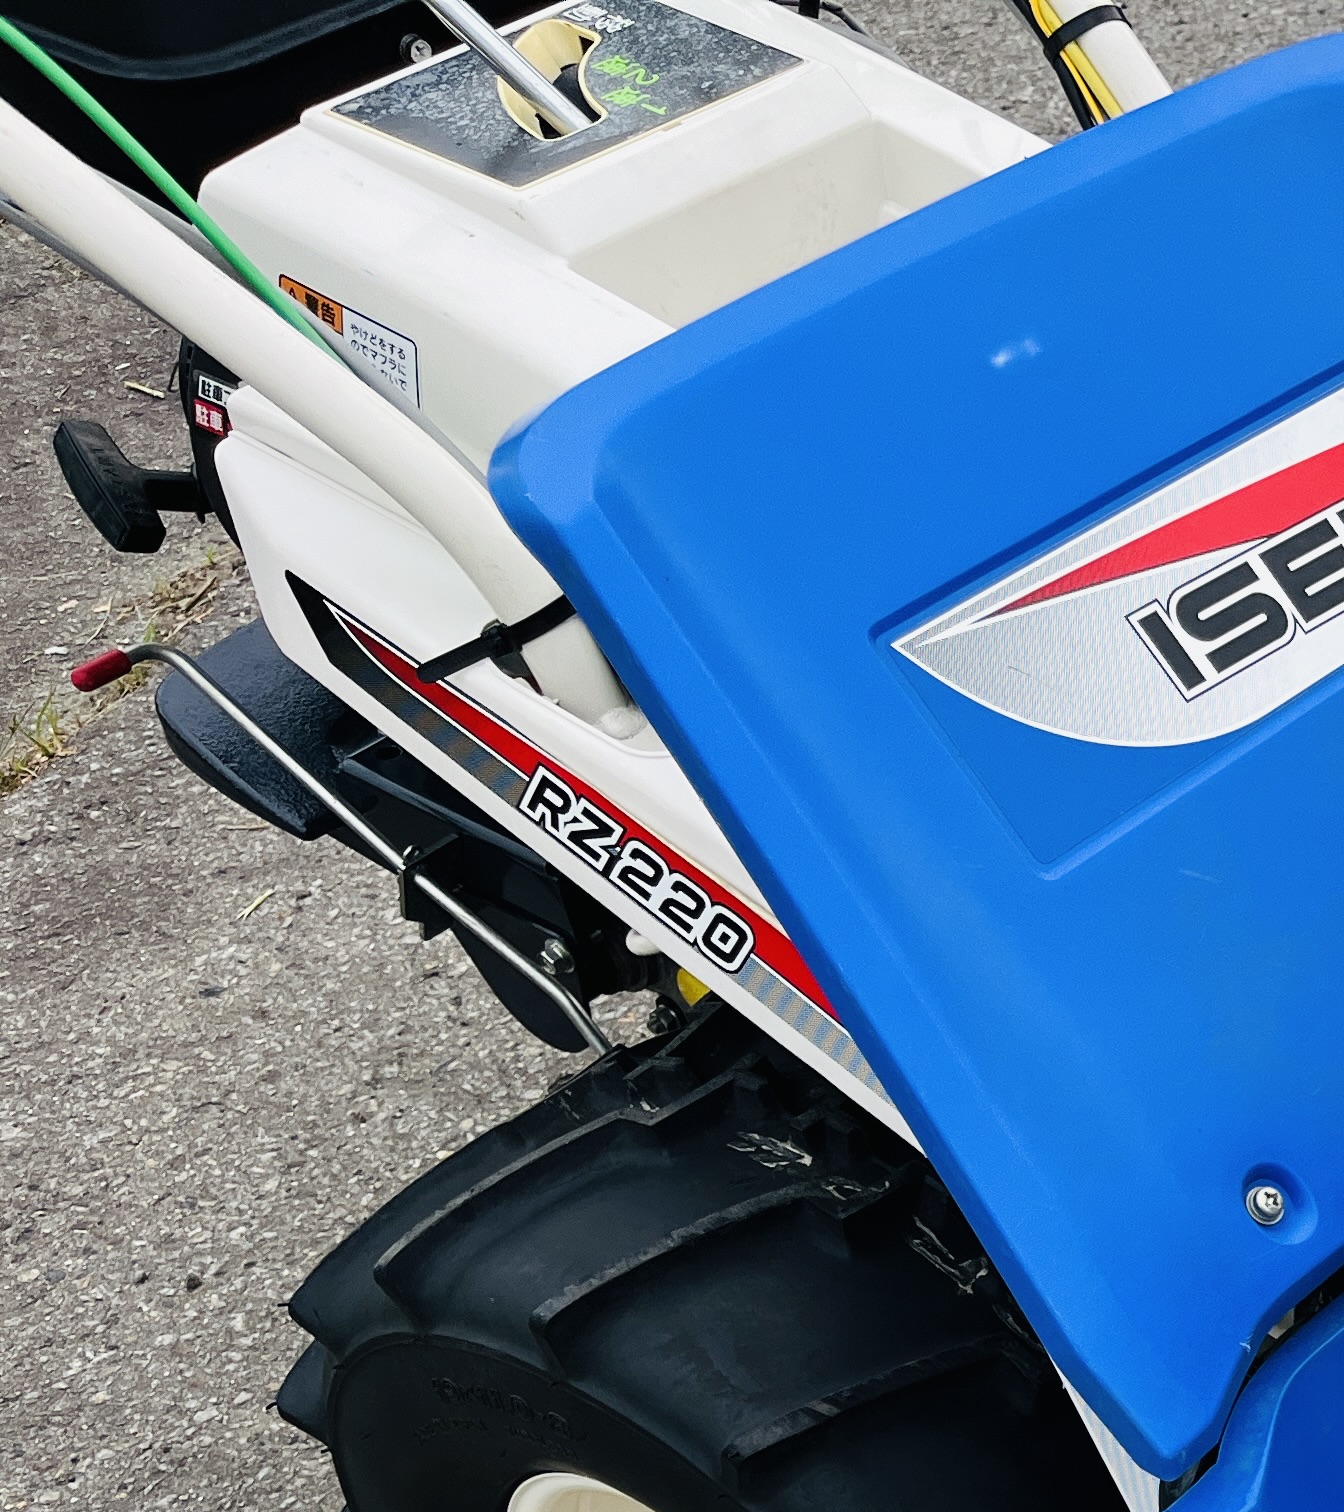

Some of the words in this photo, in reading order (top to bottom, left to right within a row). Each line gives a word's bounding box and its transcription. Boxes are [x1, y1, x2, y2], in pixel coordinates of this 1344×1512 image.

[350, 323, 406, 360] やけどをする
[522, 769, 752, 970] RZ220
